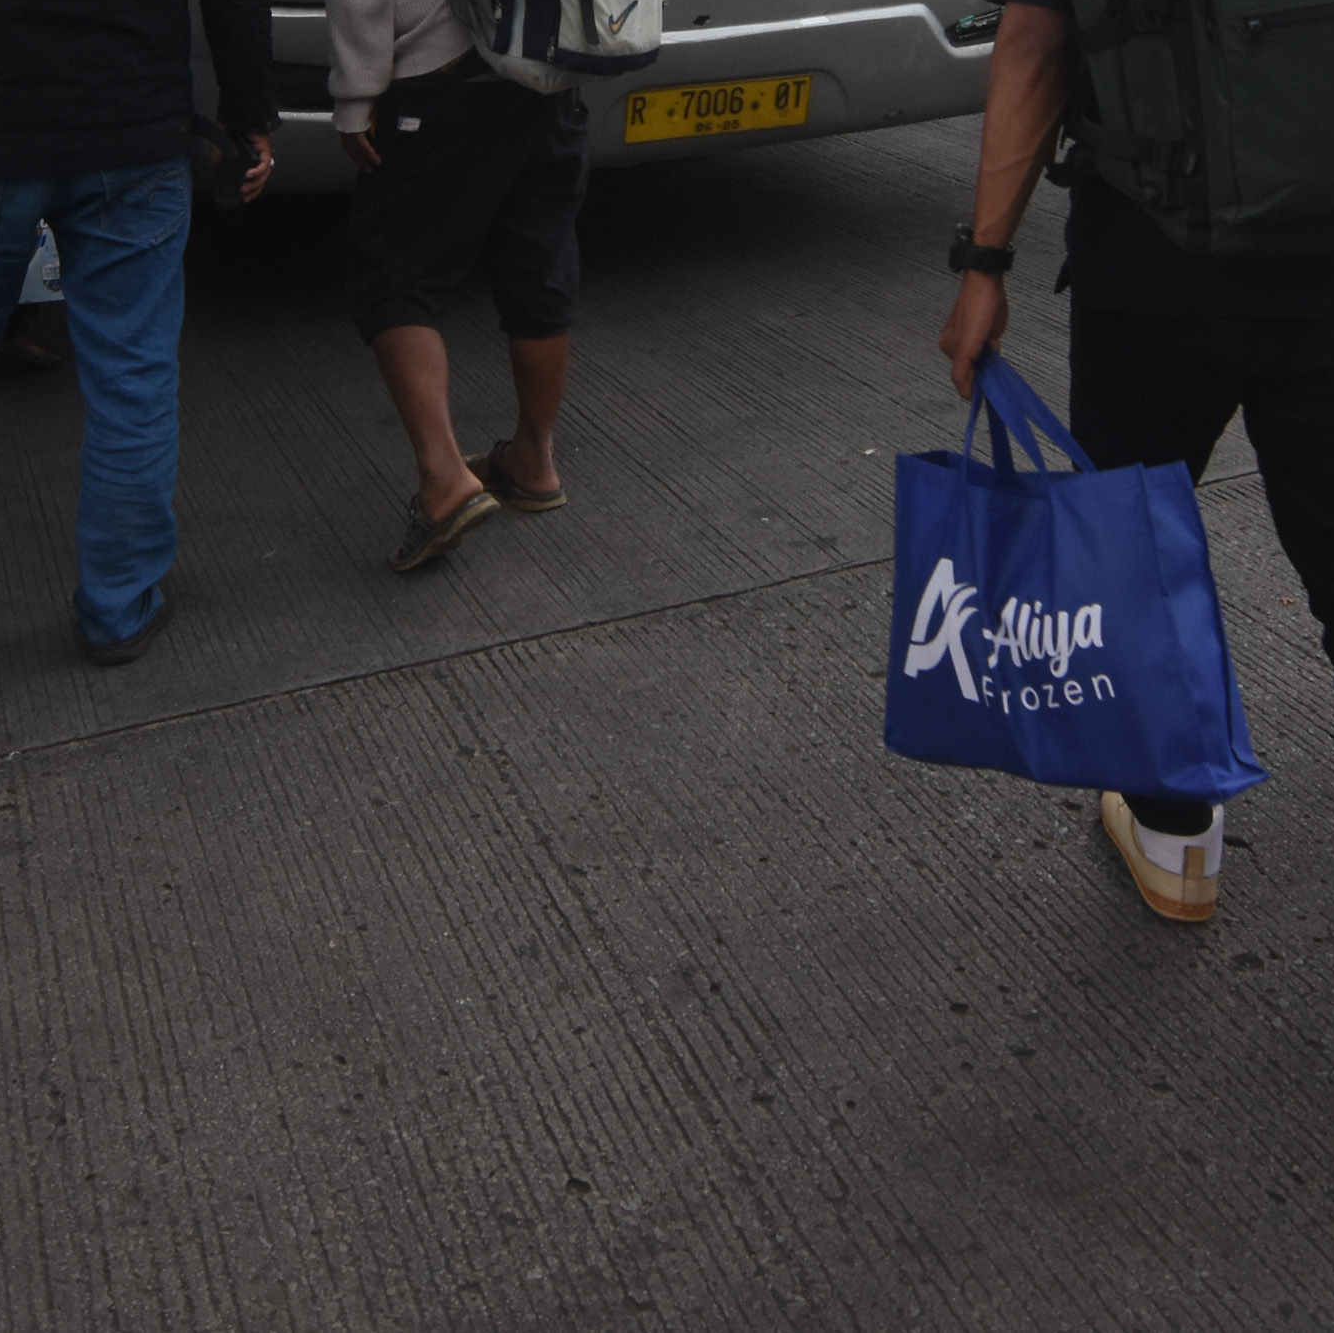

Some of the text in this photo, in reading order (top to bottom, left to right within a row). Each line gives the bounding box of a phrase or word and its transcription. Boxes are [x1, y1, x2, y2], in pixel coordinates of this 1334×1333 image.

[631, 96, 646, 125] R
[681, 86, 744, 119] 7006
[982, 596, 1104, 678] Aliya
[981, 673, 1116, 715] Frozen
